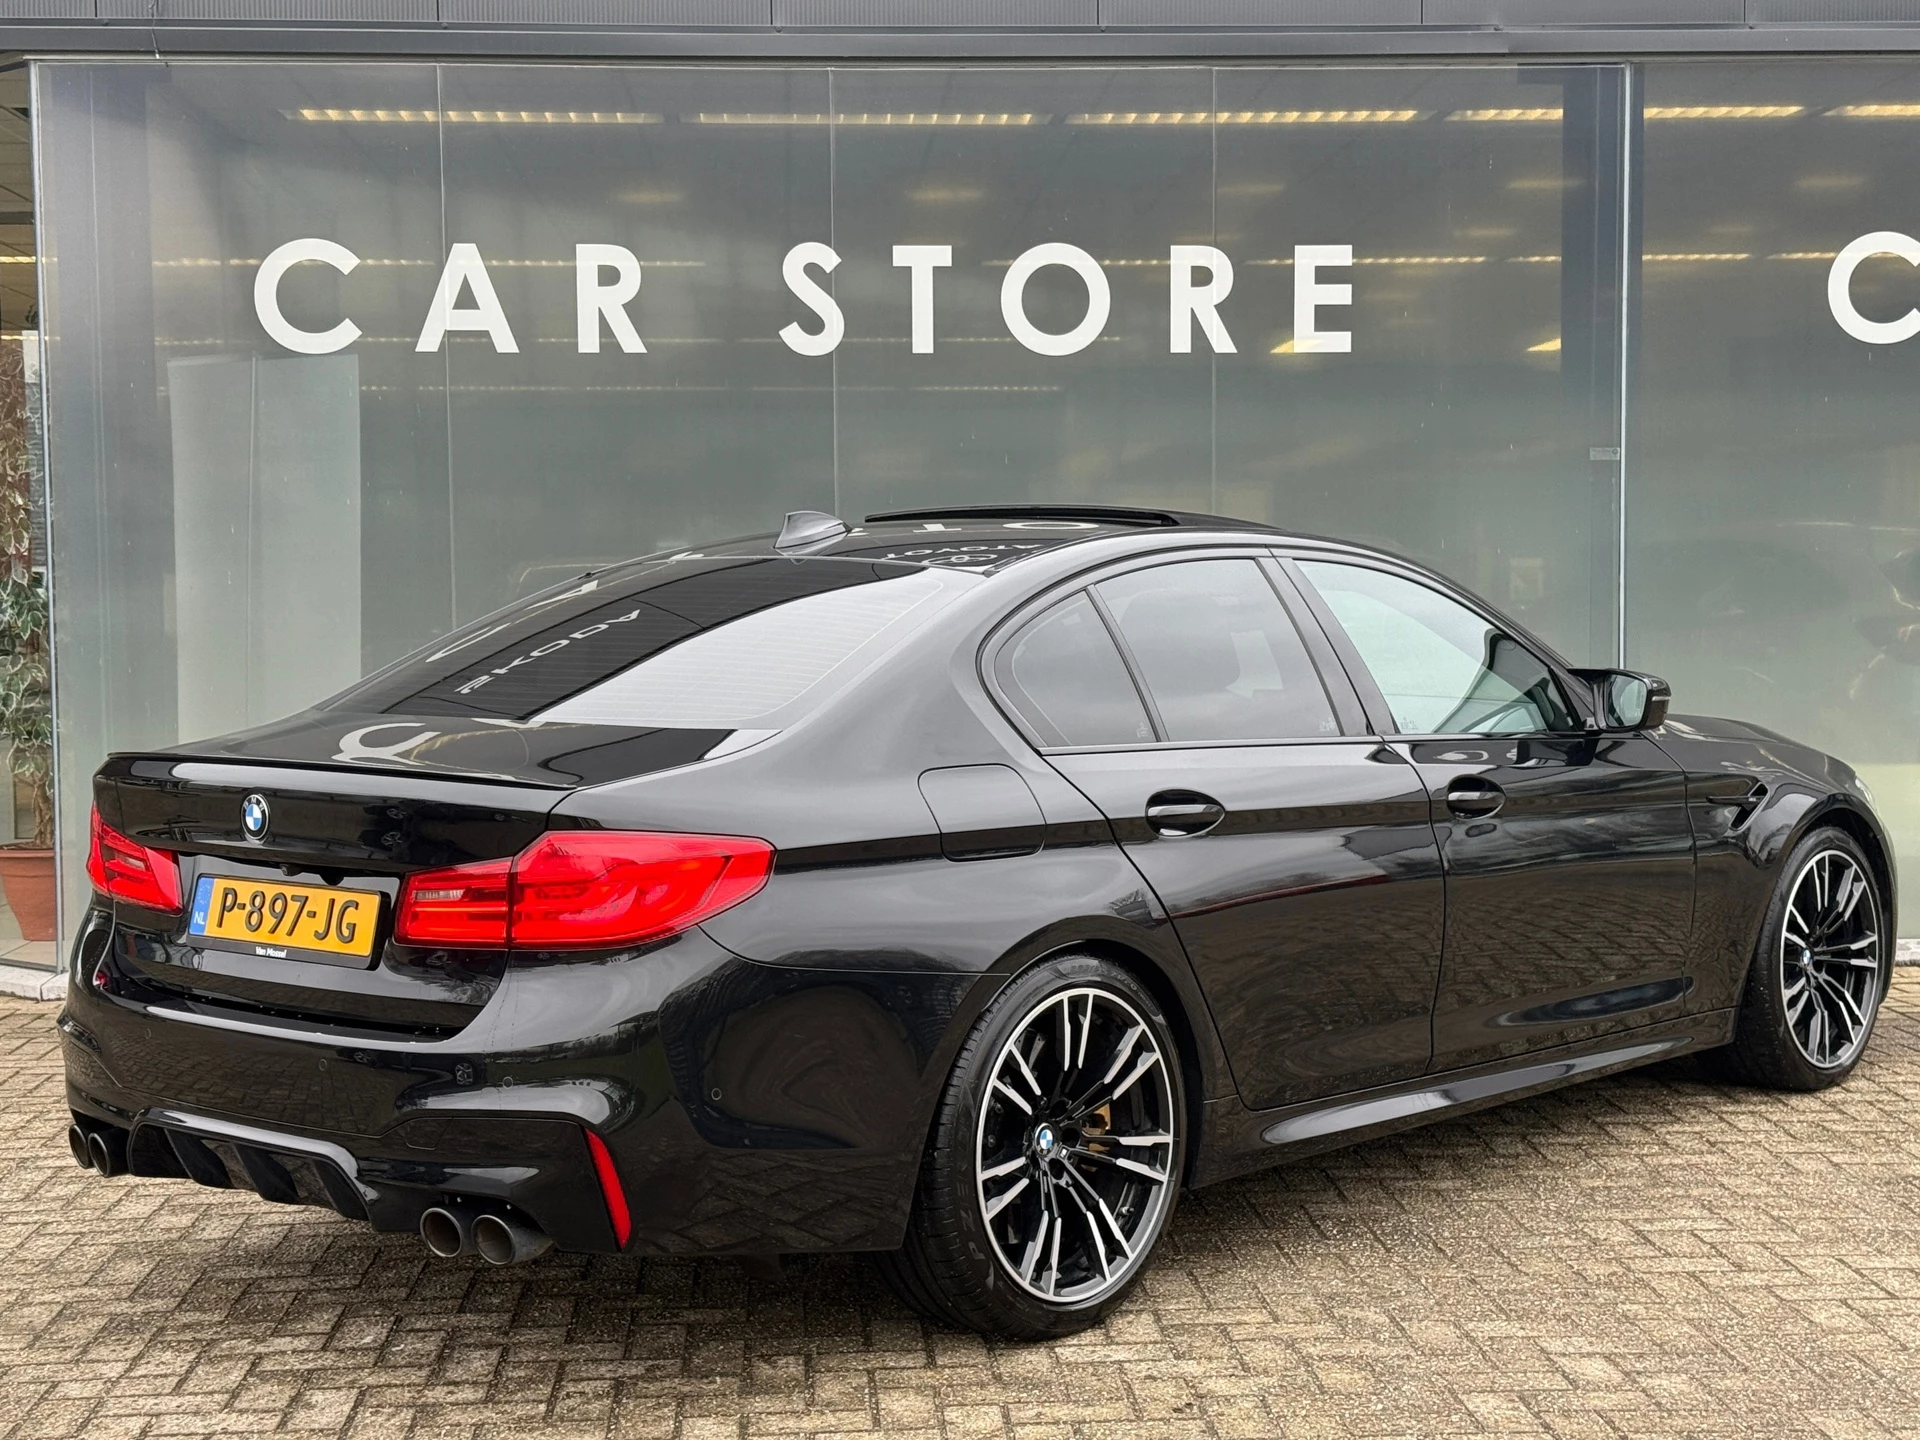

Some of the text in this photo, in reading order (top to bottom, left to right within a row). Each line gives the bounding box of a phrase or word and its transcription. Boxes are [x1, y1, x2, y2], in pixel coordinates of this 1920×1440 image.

[253, 237, 1354, 356] CAR STORE
[193, 910, 206, 926] NL
[216, 886, 360, 945] P-897-JG
[255, 945, 266, 956] Van
